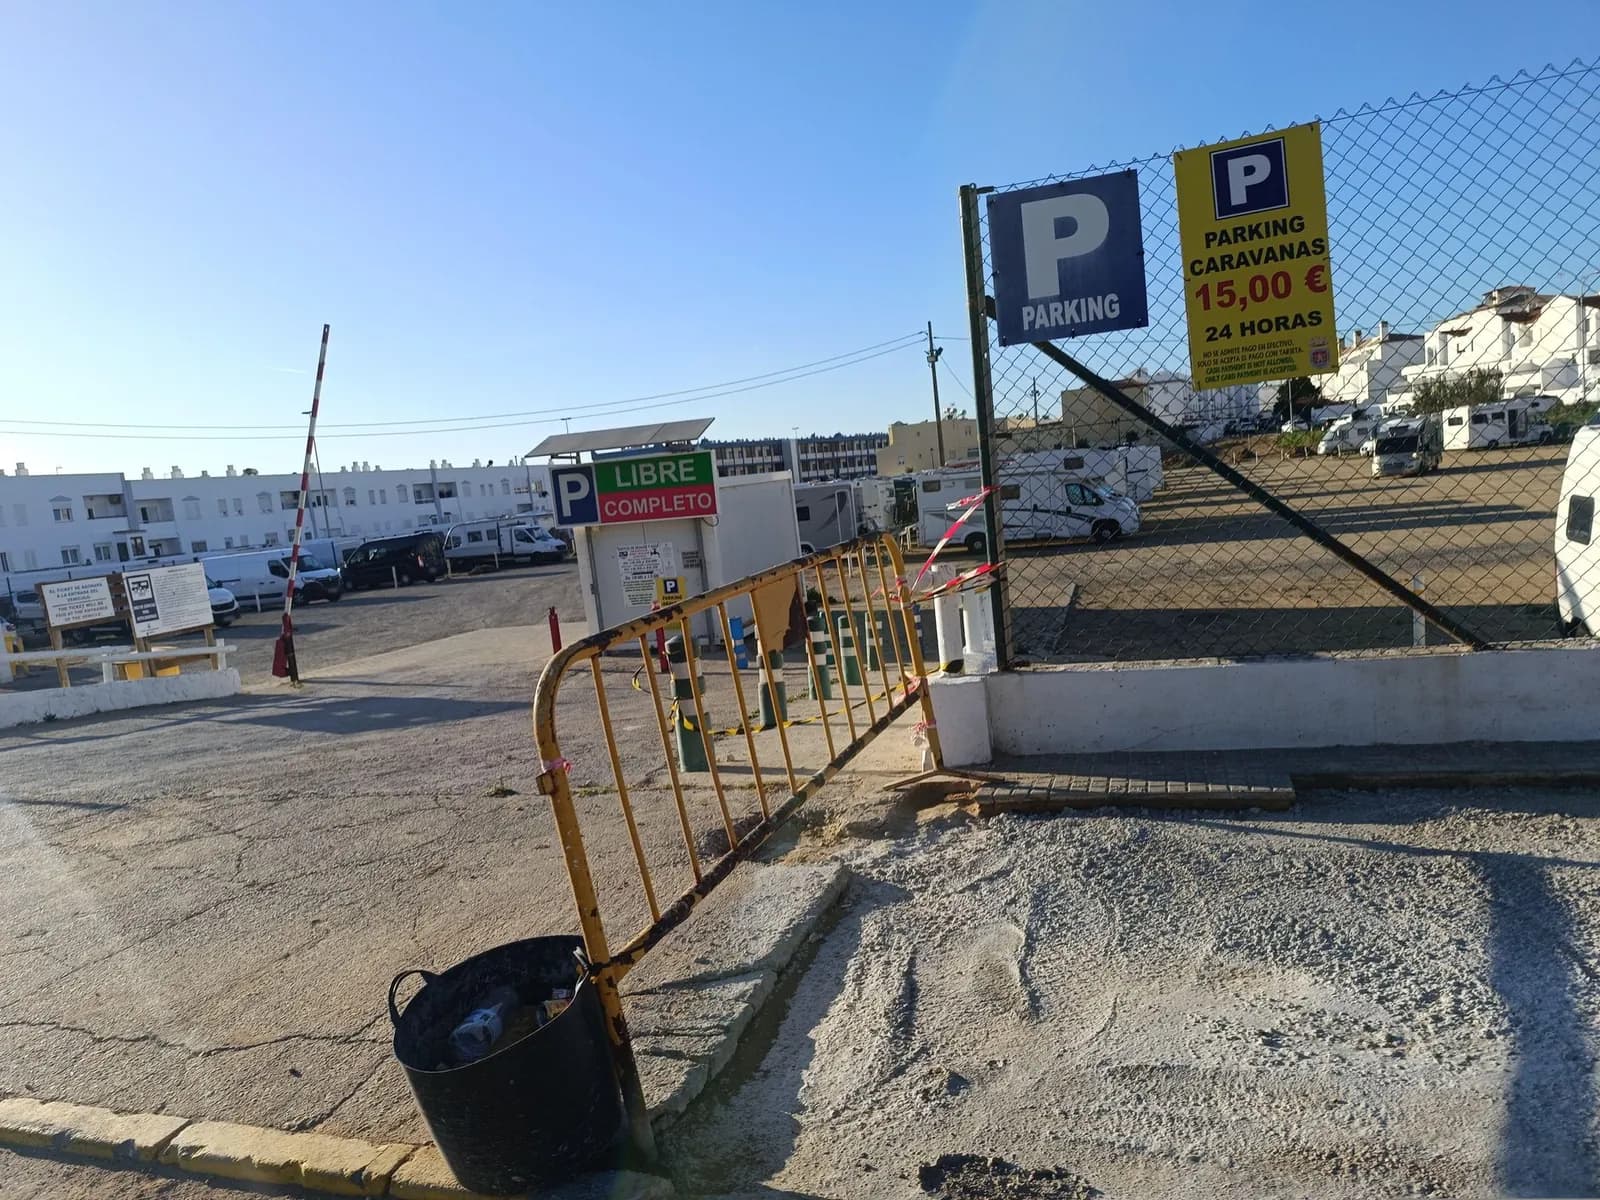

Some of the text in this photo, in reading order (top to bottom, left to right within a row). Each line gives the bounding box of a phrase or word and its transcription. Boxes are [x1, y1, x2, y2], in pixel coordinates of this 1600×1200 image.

[1227, 153, 1271, 206] P
[1021, 193, 1109, 299] P
[1204, 215, 1305, 248] PARKING
[1190, 237, 1325, 276] CARAVANAS
[1195, 264, 1328, 311] 15,00 €
[1022, 293, 1120, 331] PARKING
[1205, 310, 1323, 342] 24 HORAS
[1203, 350, 1213, 358] NO
[1220, 347, 1241, 355] ADMITE
[1241, 345, 1257, 353] PAGO
[1206, 367, 1221, 375] CASH
[1221, 364, 1246, 373] PAYMENT
[1253, 360, 1266, 368] NOT
[1220, 356, 1241, 365] ACEPTA
[1248, 353, 1264, 361] PAGO
[1265, 351, 1279, 359] CON
[1205, 375, 1220, 383] ONLY
[1220, 373, 1236, 381] CARD
[1236, 369, 1262, 379] PAYMENT
[615, 459, 697, 488] LIBRE
[558, 473, 590, 517] P
[604, 492, 712, 517] COMPLETO
[666, 580, 676, 592] P
